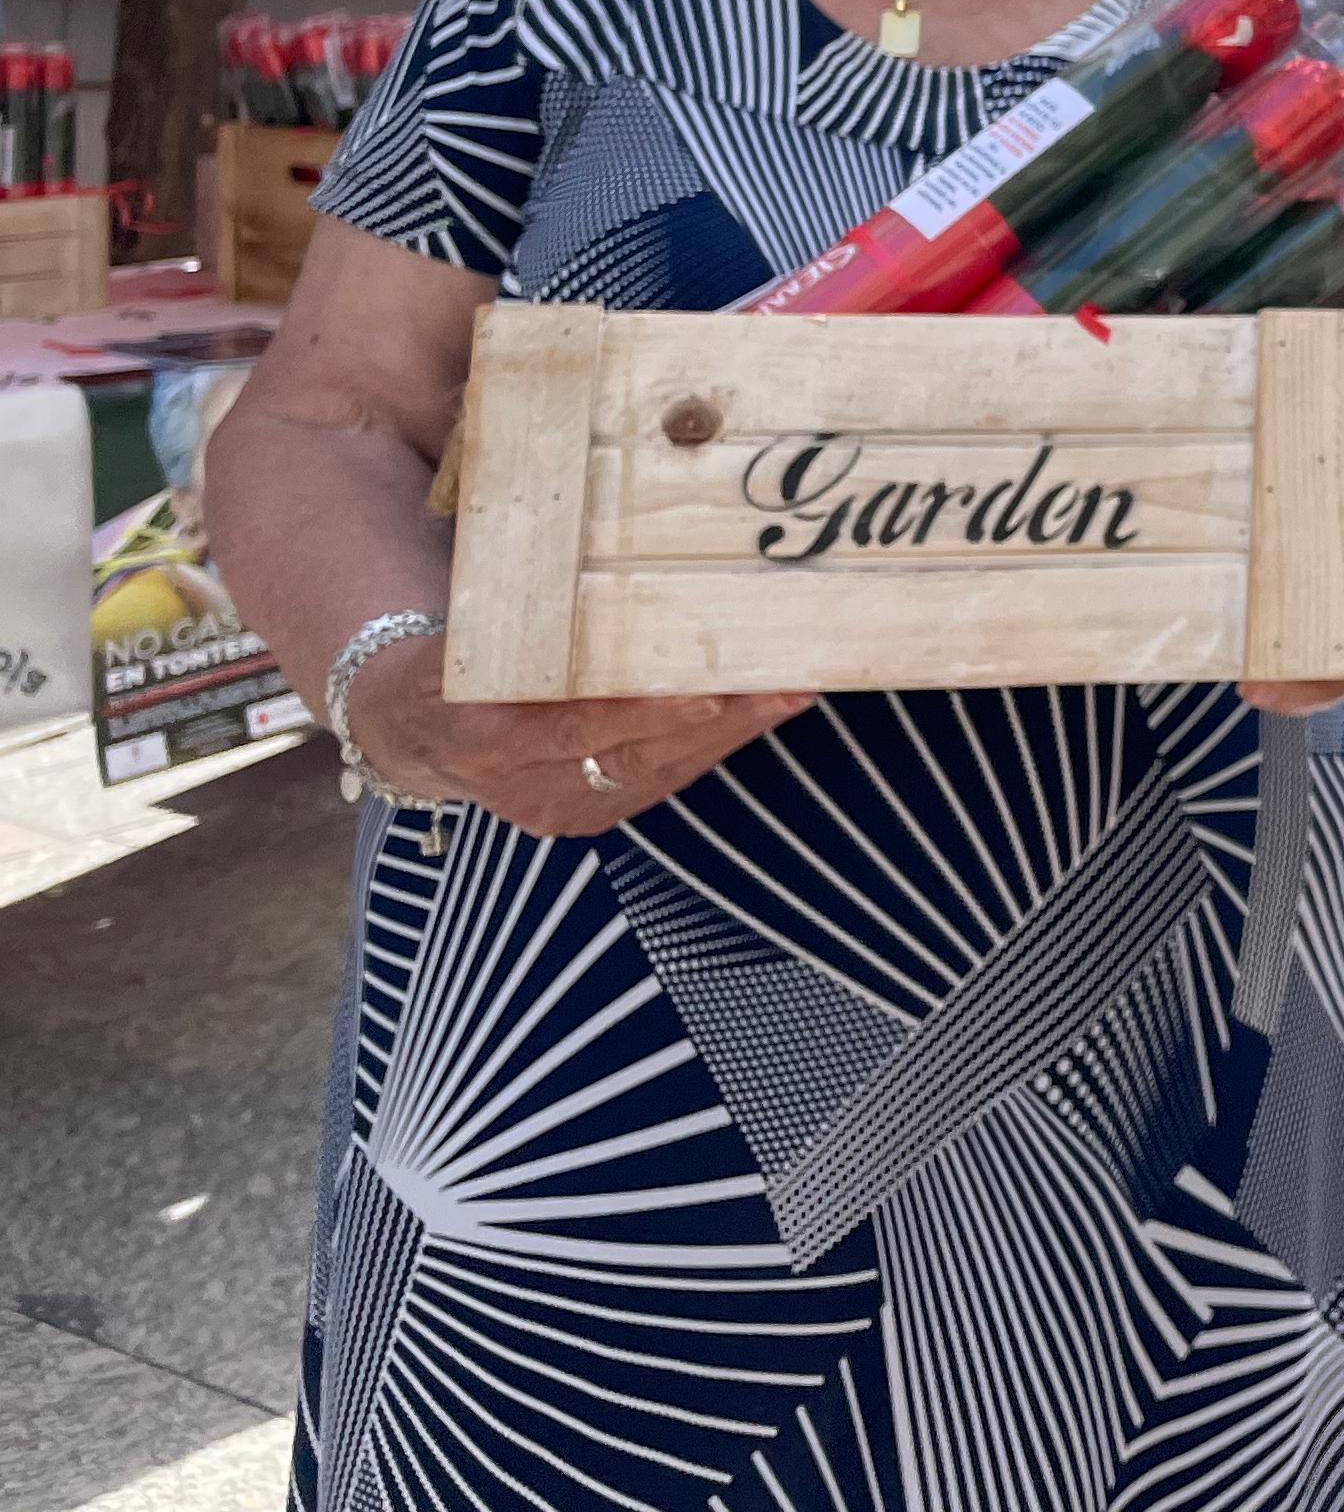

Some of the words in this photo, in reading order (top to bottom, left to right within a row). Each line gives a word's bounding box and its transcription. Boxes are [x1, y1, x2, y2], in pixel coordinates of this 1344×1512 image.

[742, 432, 1140, 565] Garden
[104, 626, 163, 667] NO
[105, 663, 146, 694] EN
